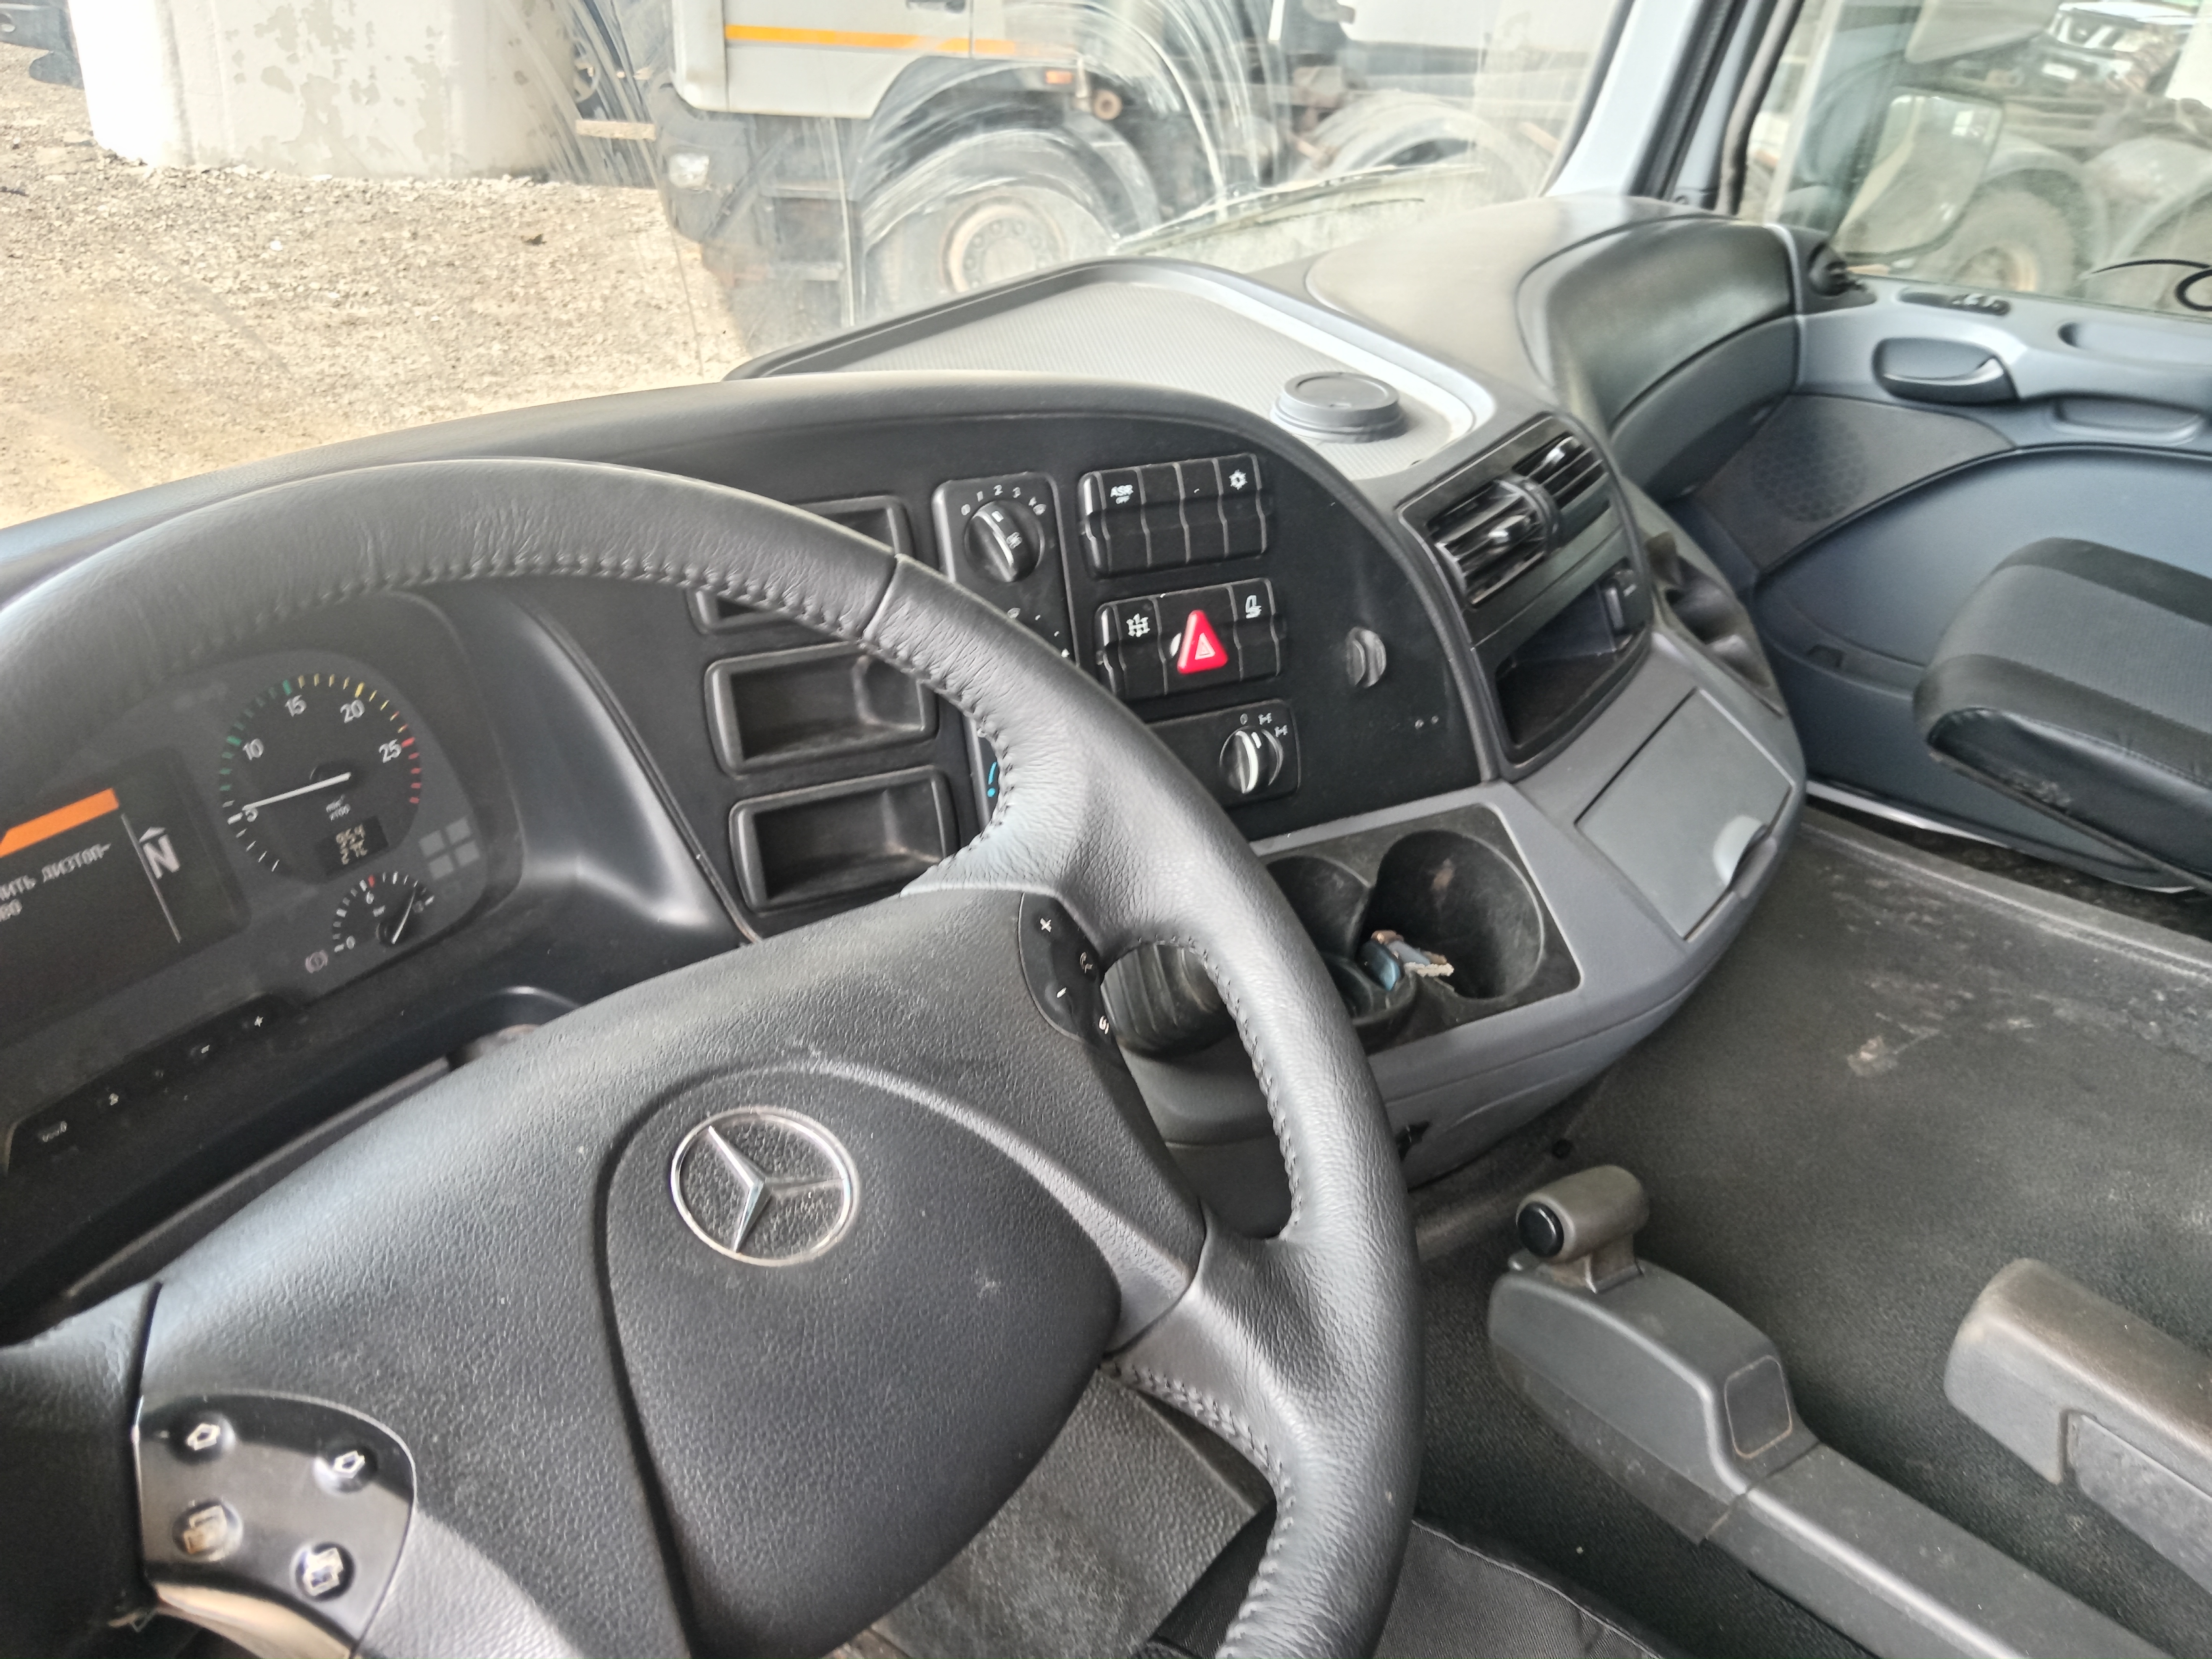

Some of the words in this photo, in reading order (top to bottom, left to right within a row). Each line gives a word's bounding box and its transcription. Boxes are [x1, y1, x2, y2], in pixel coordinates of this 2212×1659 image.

[1110, 484, 1134, 497] ASR
[285, 695, 307, 717] 15
[340, 699, 365, 723] 20
[243, 738, 264, 760] 10
[378, 739, 401, 763] 25
[143, 834, 180, 879] N
[366, 891, 374, 904] 6
